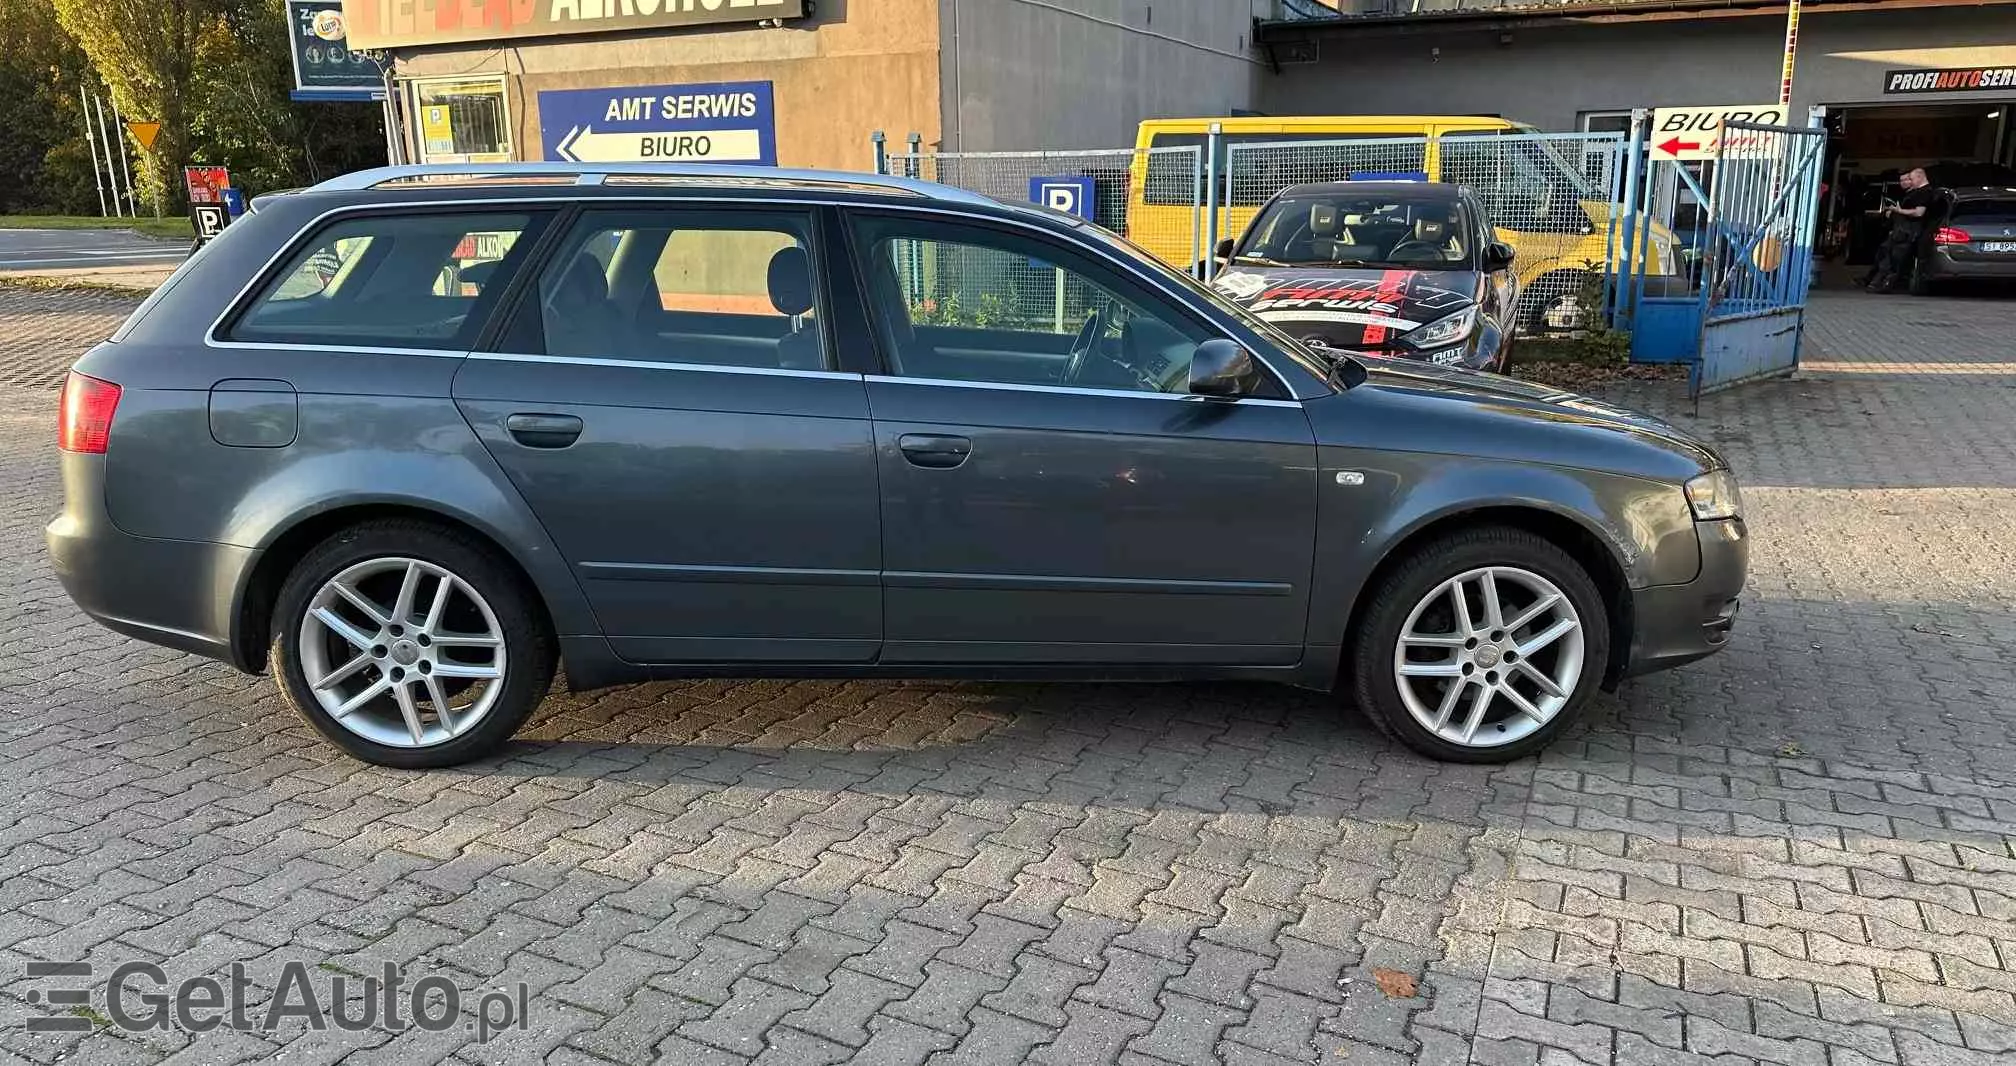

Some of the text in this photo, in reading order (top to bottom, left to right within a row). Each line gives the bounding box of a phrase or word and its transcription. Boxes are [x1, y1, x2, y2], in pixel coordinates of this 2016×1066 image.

[605, 93, 756, 121] AMT SERWIS
[640, 136, 711, 157] BIURO
